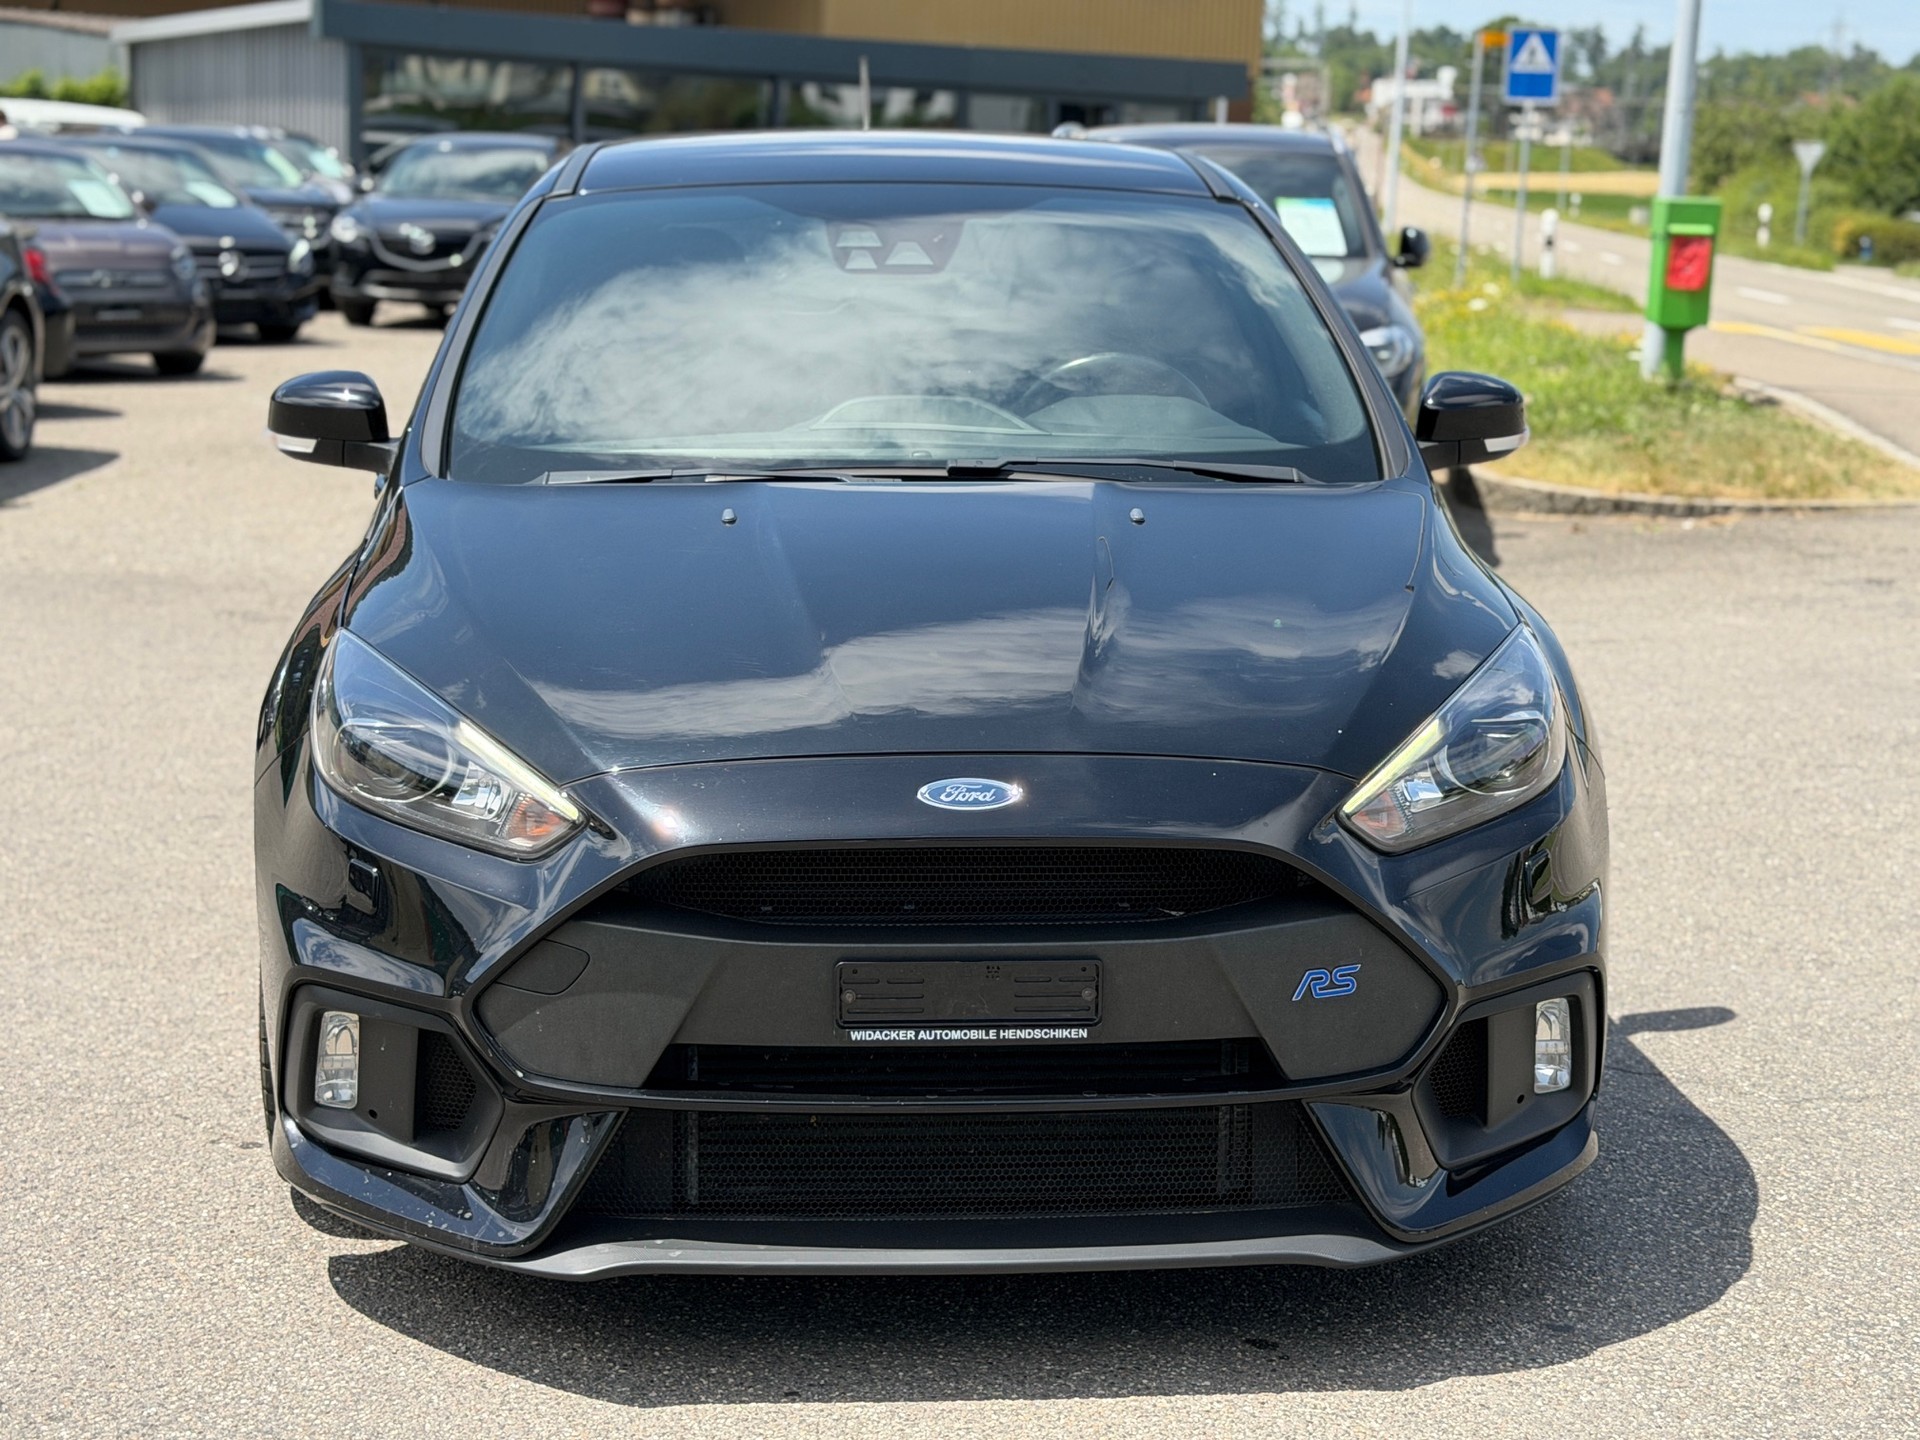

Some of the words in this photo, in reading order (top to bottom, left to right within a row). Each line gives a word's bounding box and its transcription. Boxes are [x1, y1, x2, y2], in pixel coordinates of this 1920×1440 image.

[940, 784, 996, 802] Ford
[1291, 964, 1362, 1001] RS
[850, 1030, 916, 1041] WIDACKER
[917, 1029, 997, 1040] AUTOMOBILE
[999, 1028, 1088, 1039] HENDSCHIKEN
